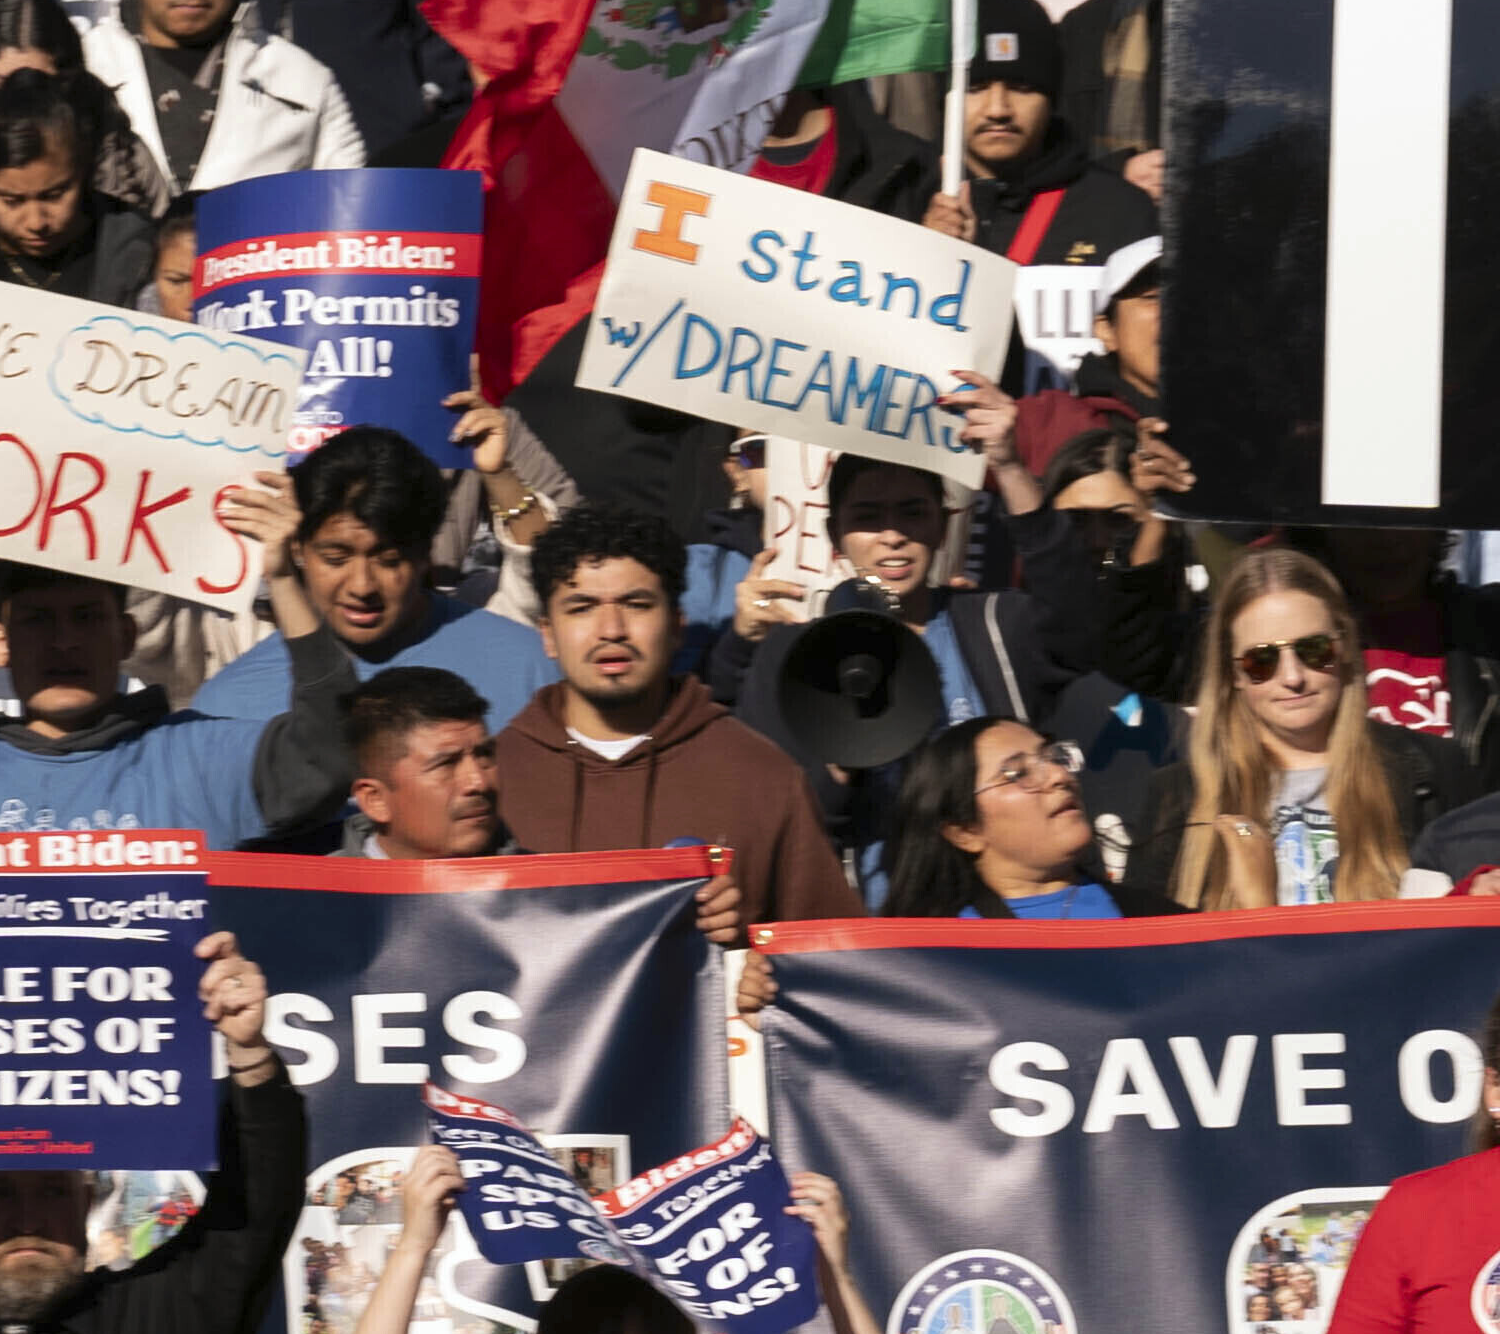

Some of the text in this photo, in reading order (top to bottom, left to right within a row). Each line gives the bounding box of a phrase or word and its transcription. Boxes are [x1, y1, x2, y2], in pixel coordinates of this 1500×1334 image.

[632, 179, 974, 333] I stand
[38, 836, 199, 867] Biden:
[68, 893, 207, 929] Together
[52, 966, 174, 1003] FOR
[96, 1017, 175, 1054] OF
[989, 1032, 1352, 1138] SAVE
[481, 1210, 560, 1231] US
[705, 1231, 774, 1290] OF
